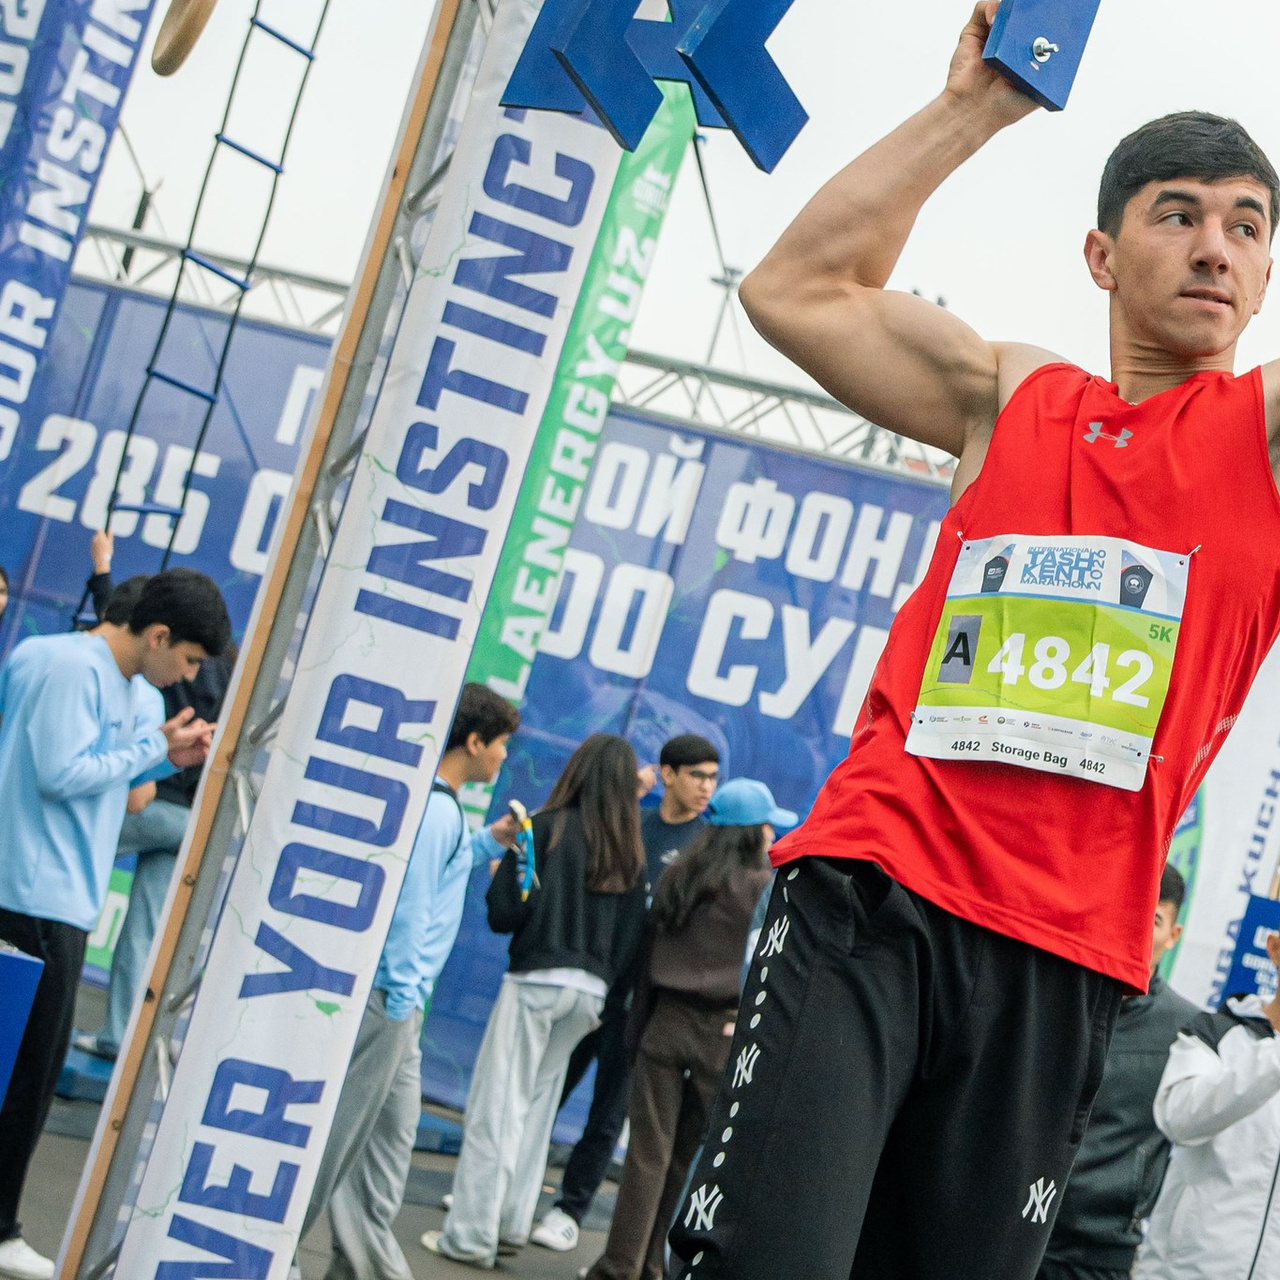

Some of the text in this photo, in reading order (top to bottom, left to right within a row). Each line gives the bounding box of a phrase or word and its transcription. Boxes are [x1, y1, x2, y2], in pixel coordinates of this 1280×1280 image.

[17, 412, 221, 556] 285
[238, 672, 437, 1000] YOUR
[354, 106, 607, 641] INSTINC
[1027, 548, 1094, 571] TASH
[1020, 577, 1091, 590] MARATHON
[1021, 562, 1087, 583] KENT
[941, 631, 971, 666] A
[1149, 624, 1173, 643] 5K
[987, 632, 1154, 709] 4842
[951, 740, 1106, 775] 4842 Storage Bag 4842
